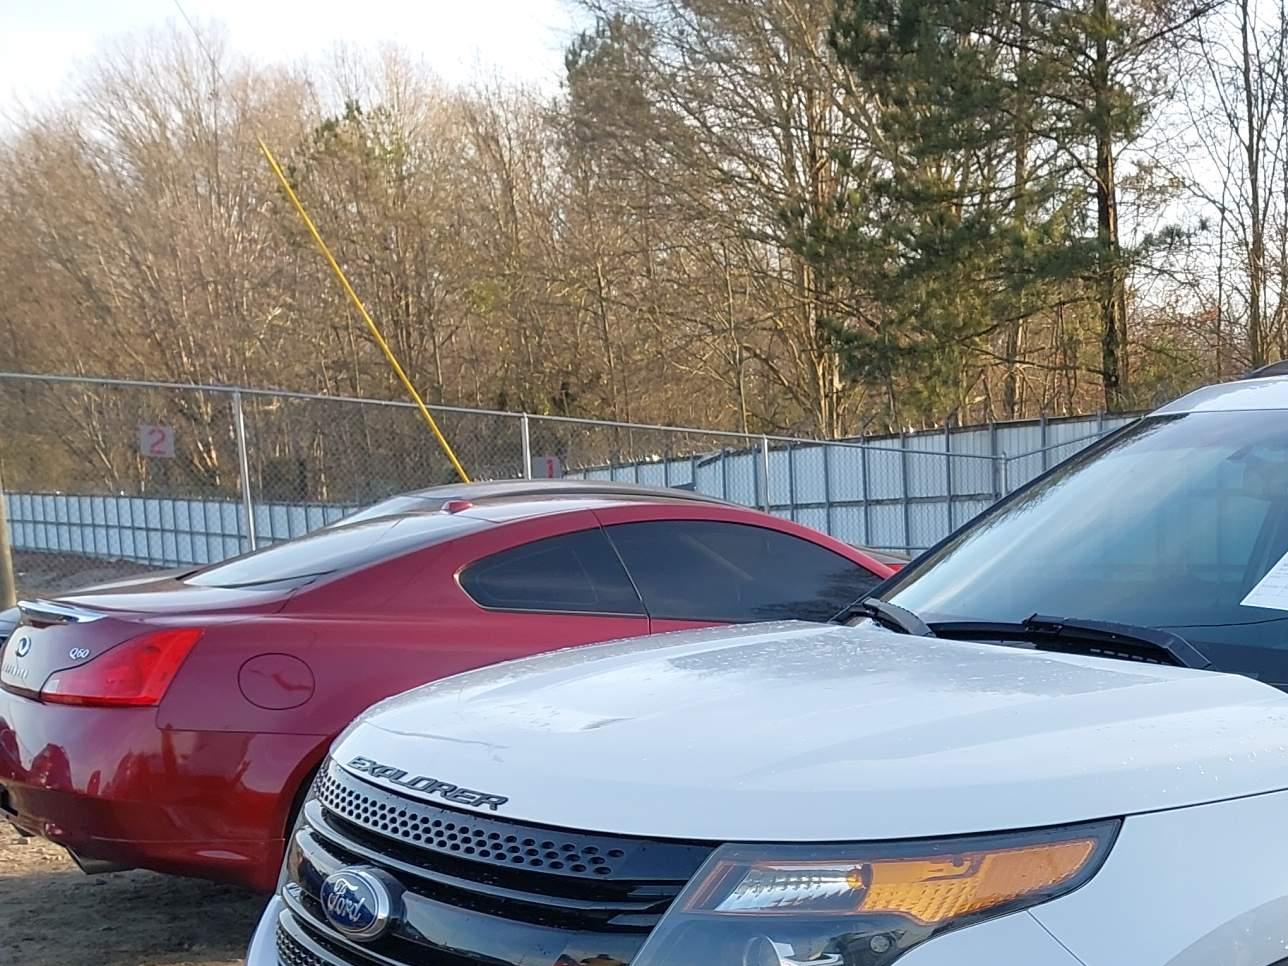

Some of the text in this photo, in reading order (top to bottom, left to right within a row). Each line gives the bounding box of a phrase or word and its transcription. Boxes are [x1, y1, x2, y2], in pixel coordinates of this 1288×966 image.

[149, 429, 167, 455] 2
[69, 647, 90, 660] Q60
[347, 755, 509, 811] EXPLORER
[327, 878, 366, 922] Ford
